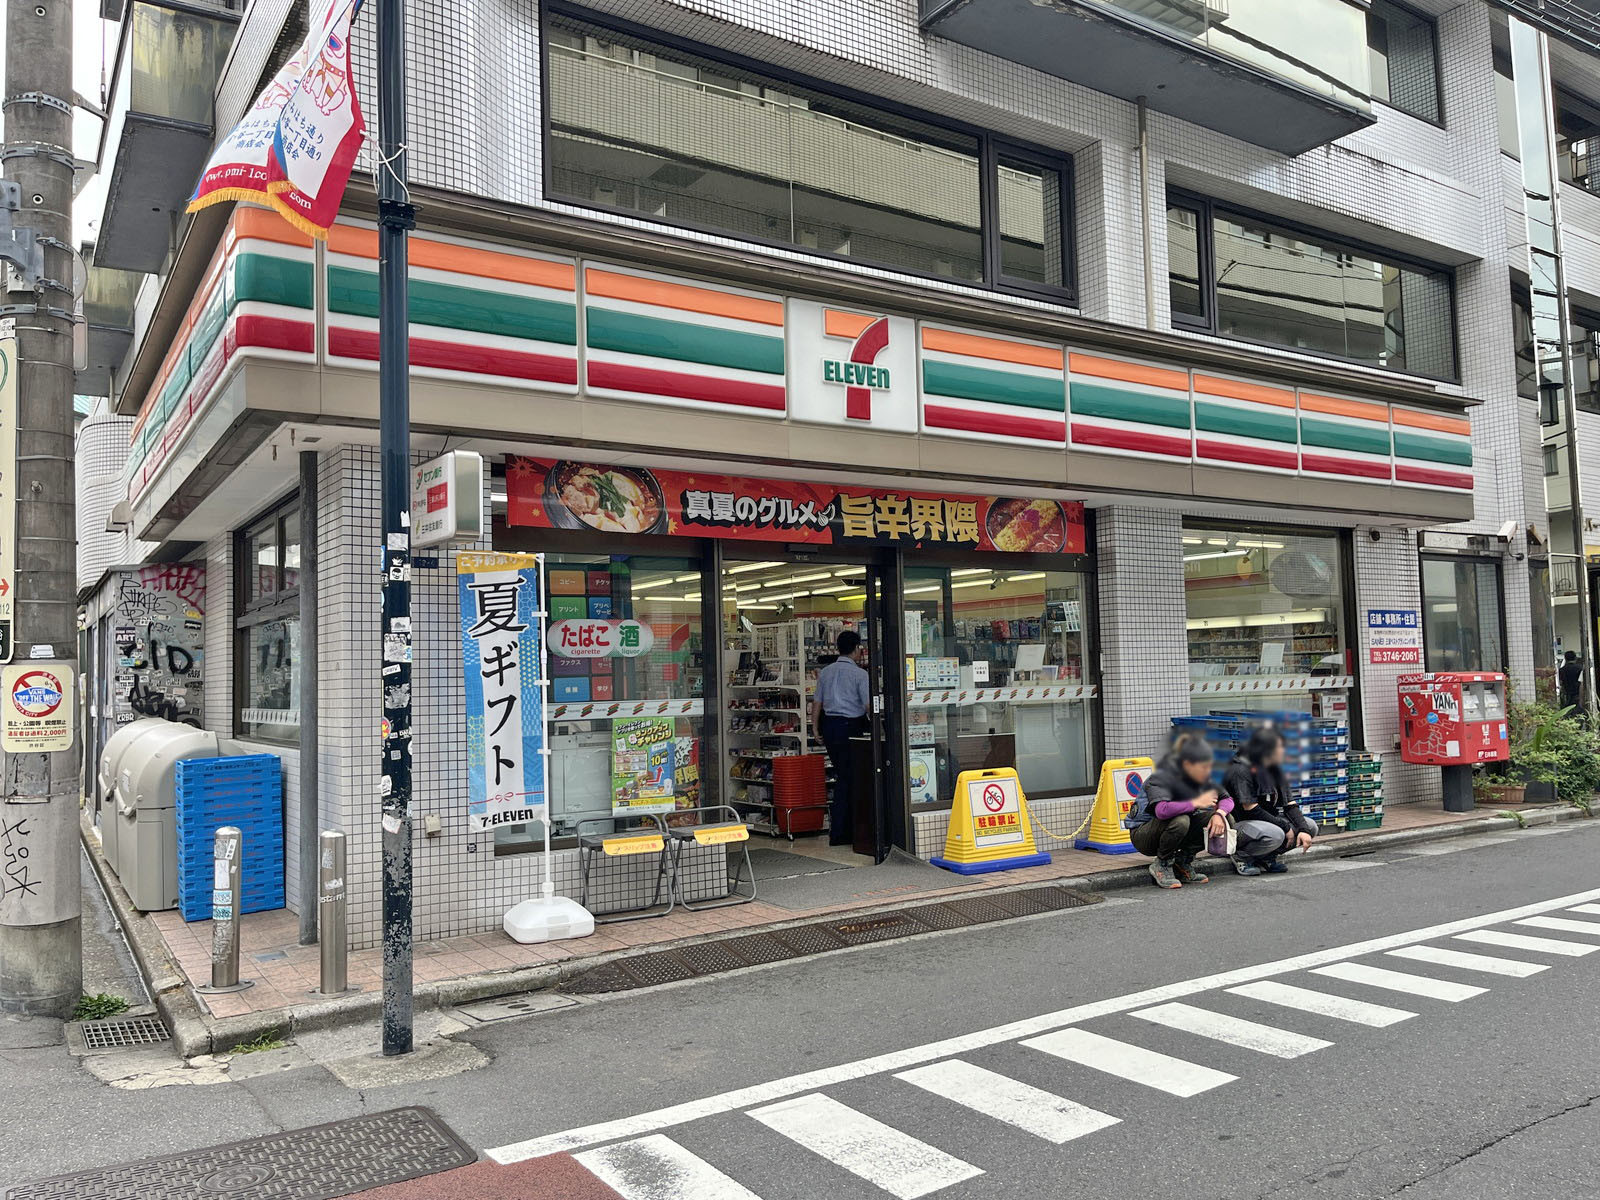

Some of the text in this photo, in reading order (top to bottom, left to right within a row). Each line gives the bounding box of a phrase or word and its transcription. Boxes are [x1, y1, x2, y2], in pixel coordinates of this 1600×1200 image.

[685, 489, 818, 525] 真夏のグルメ
[839, 493, 980, 543] 旨辛界隈
[116, 633, 135, 642] ART
[561, 623, 641, 648] たばこ 酒
[1383, 651, 1418, 662] 3746-2061
[467, 576, 527, 786] 夏ギフト
[977, 813, 1017, 828] 駐輪禁止
